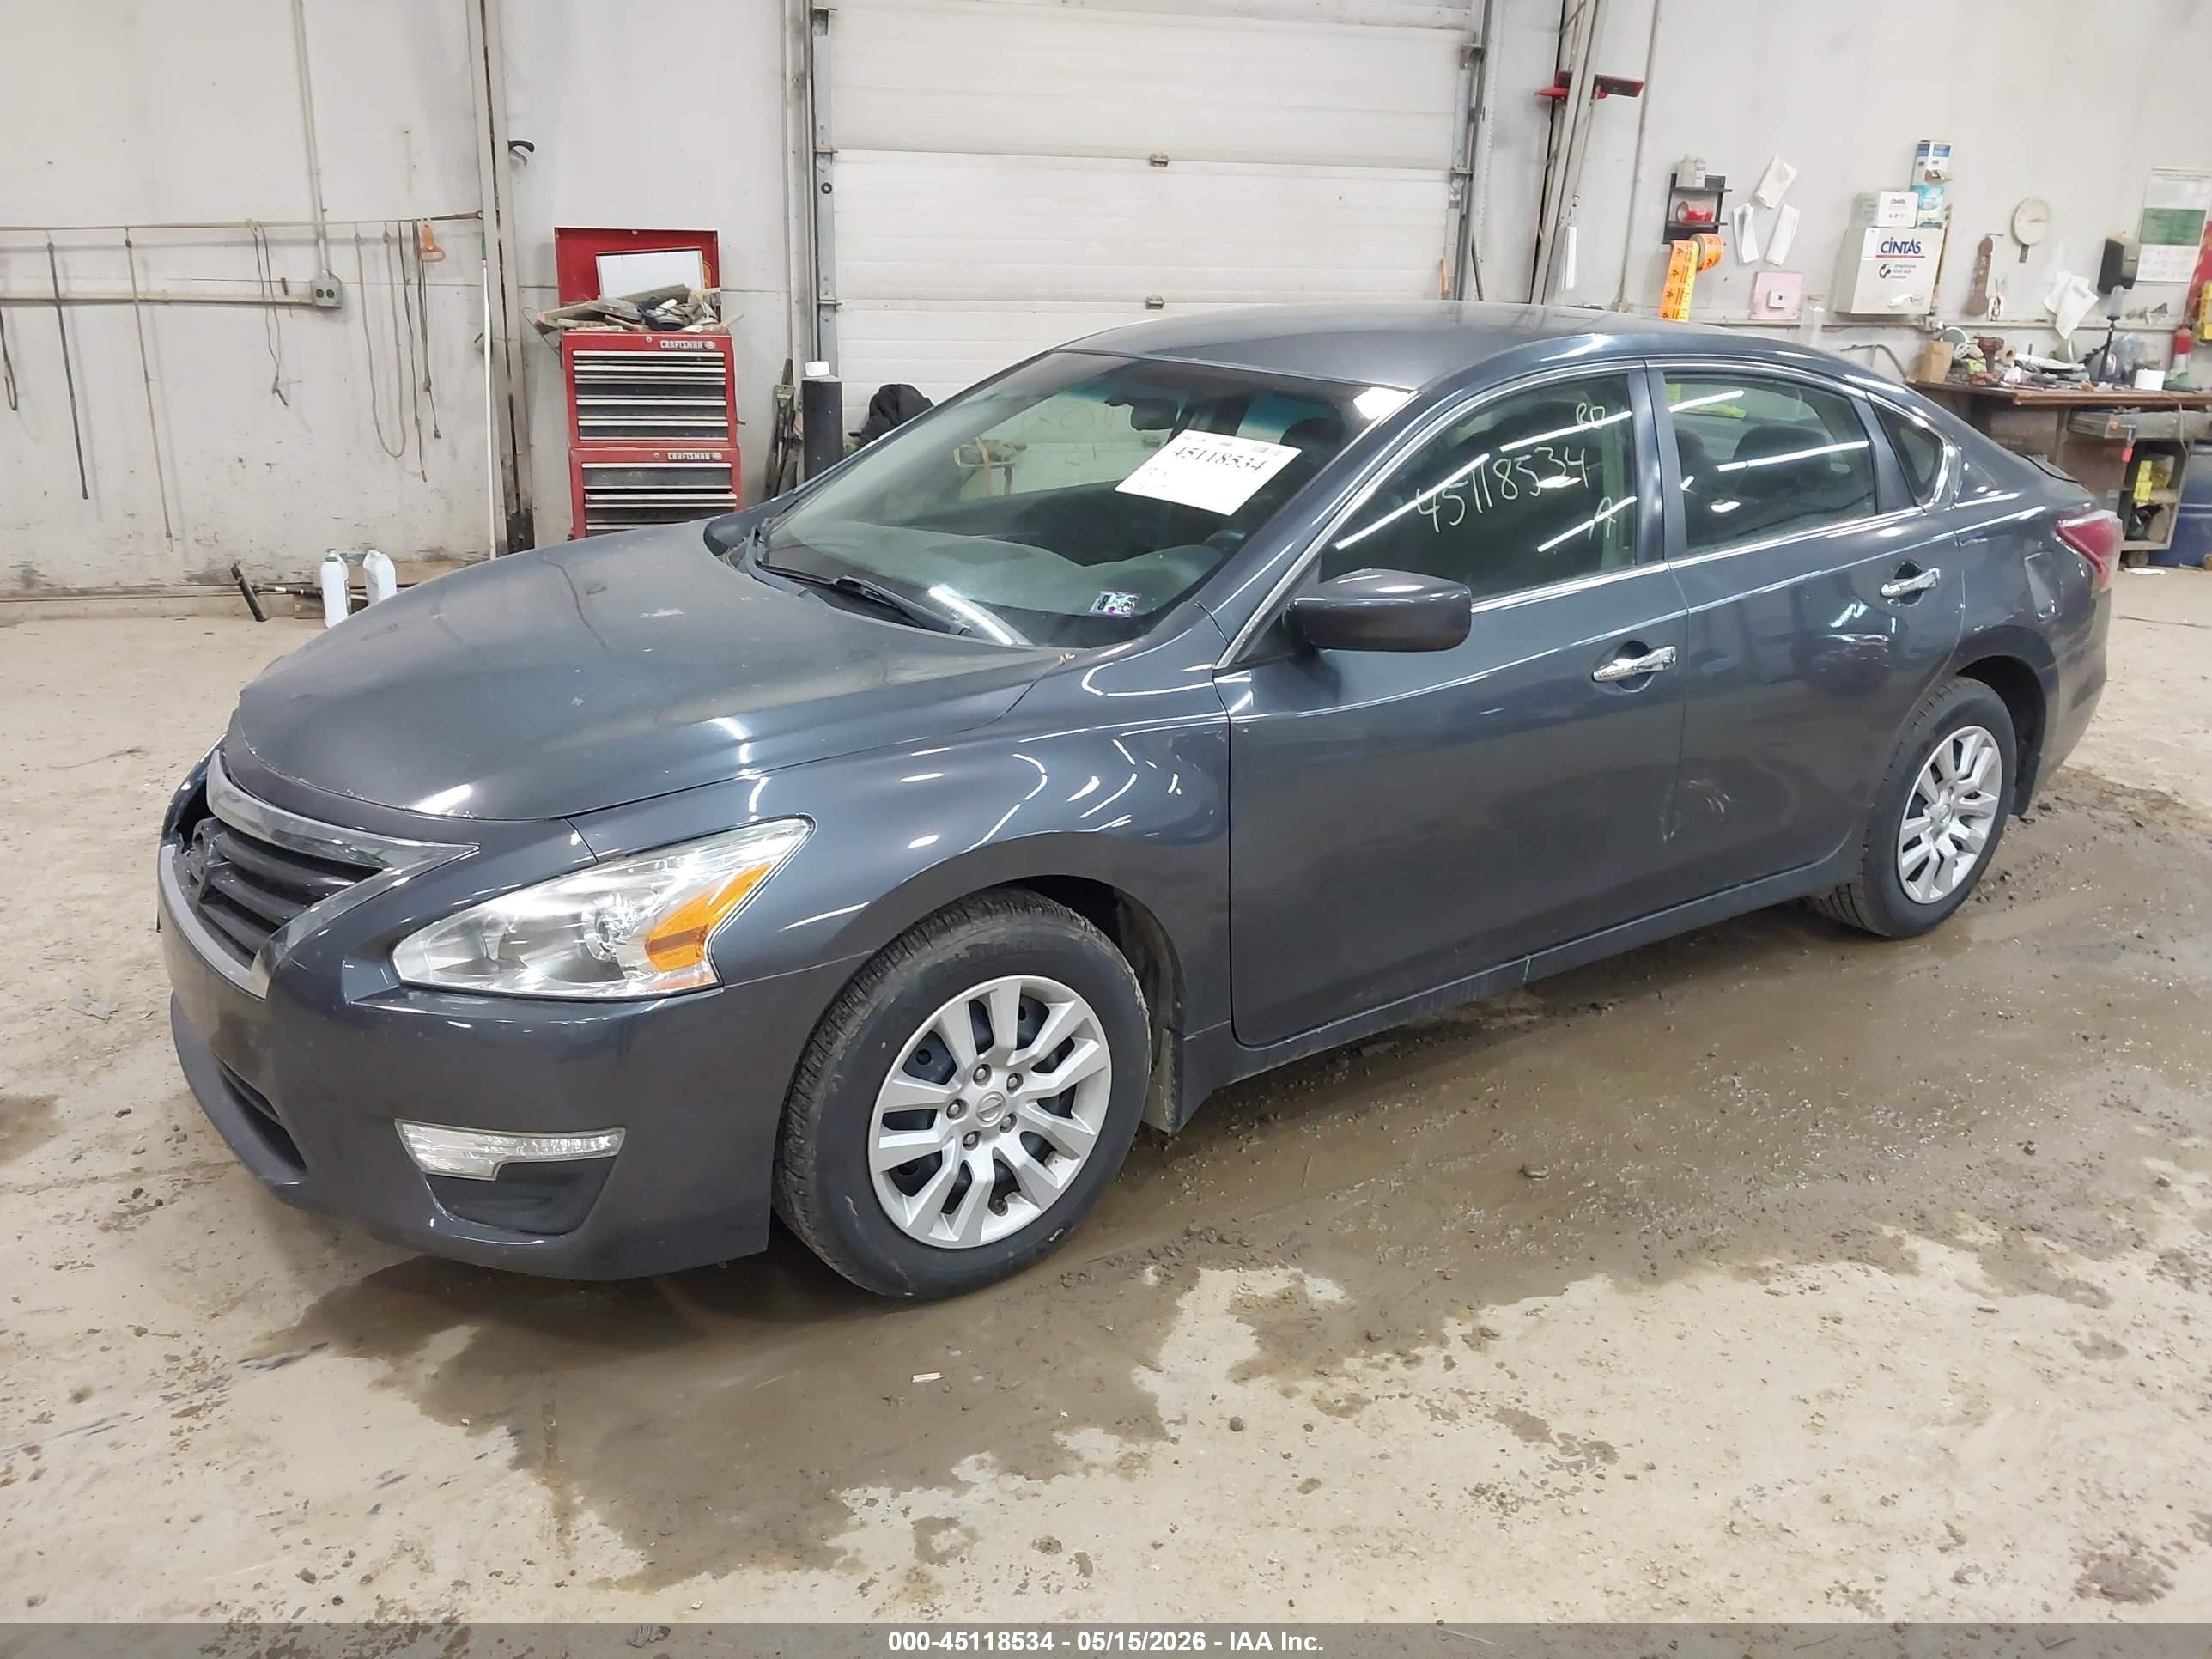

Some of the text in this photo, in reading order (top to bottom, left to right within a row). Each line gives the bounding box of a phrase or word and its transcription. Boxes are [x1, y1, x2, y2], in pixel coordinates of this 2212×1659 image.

[659, 339, 703, 349] CRAFTSMAN
[667, 451, 711, 461] CRAFTSMAN
[1172, 446, 1268, 471] 45118534
[1416, 446, 1589, 532] 45118534
